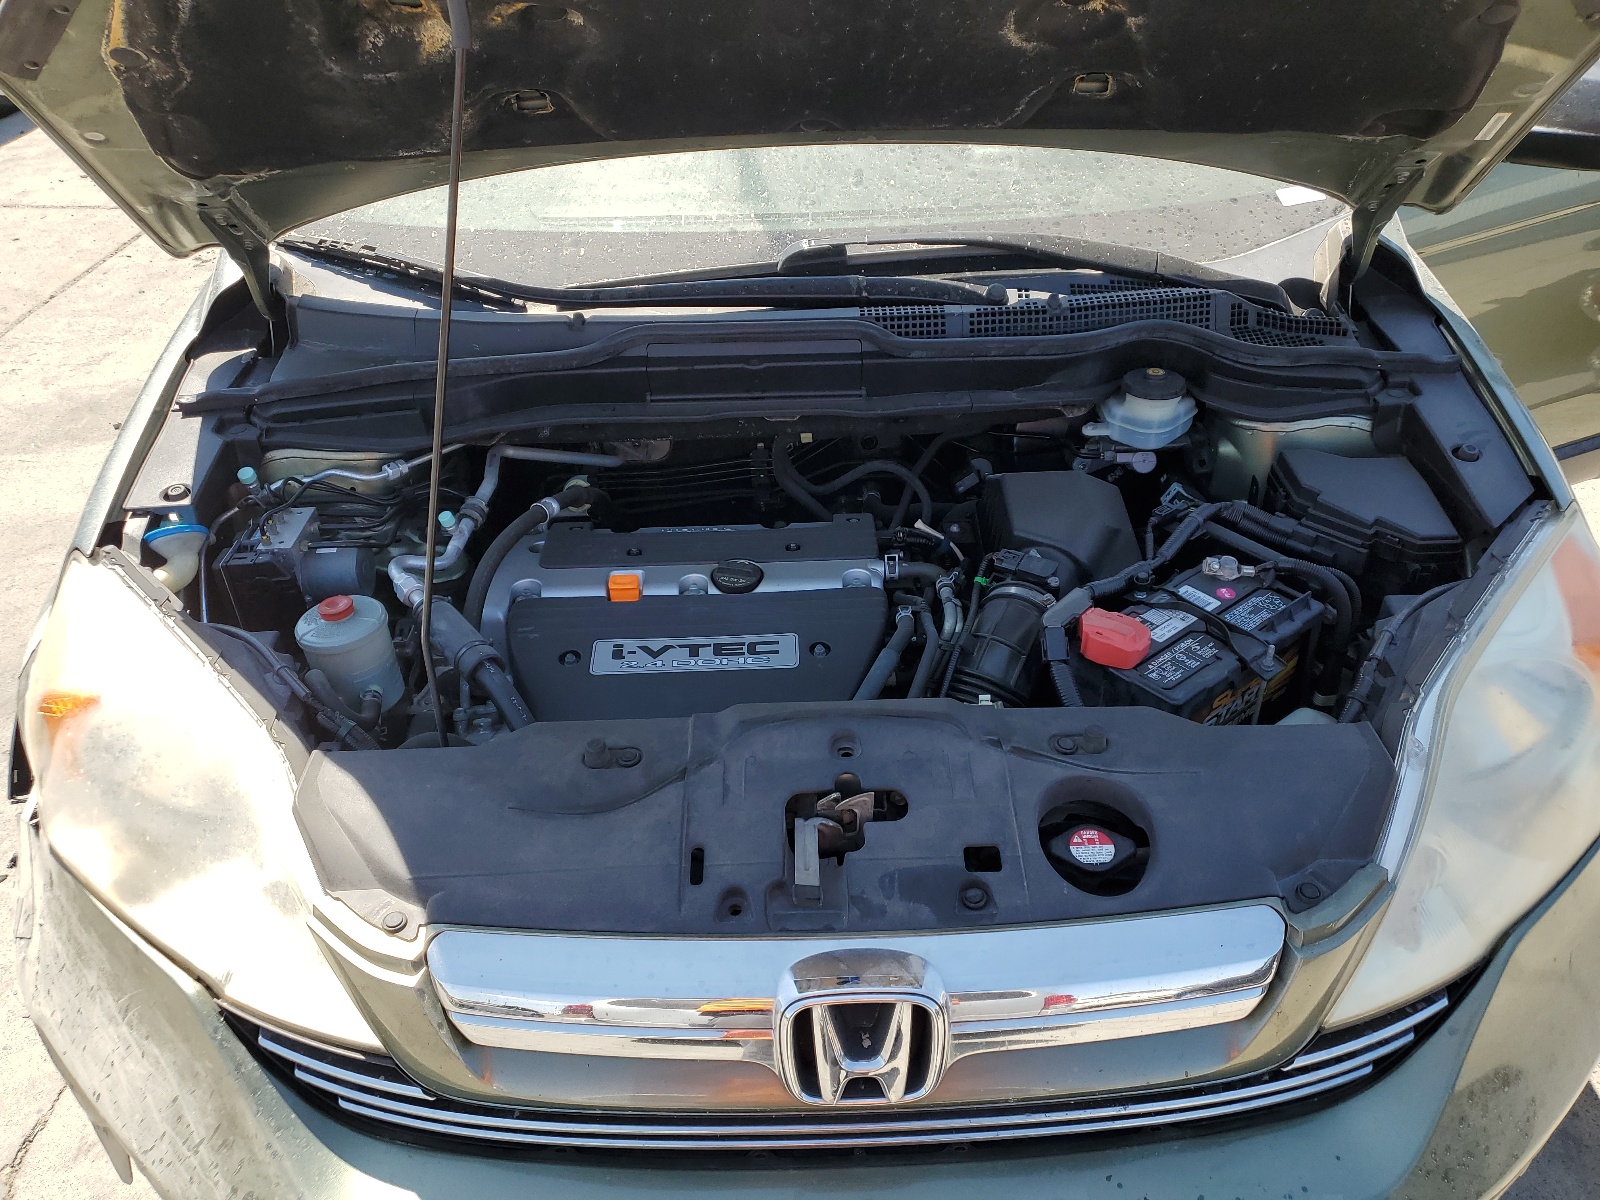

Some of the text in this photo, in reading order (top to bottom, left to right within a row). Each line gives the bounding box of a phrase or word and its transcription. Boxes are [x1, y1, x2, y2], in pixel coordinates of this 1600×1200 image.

[611, 640, 780, 660] i-VTEC
[619, 656, 771, 669] 2.4 DOHC
